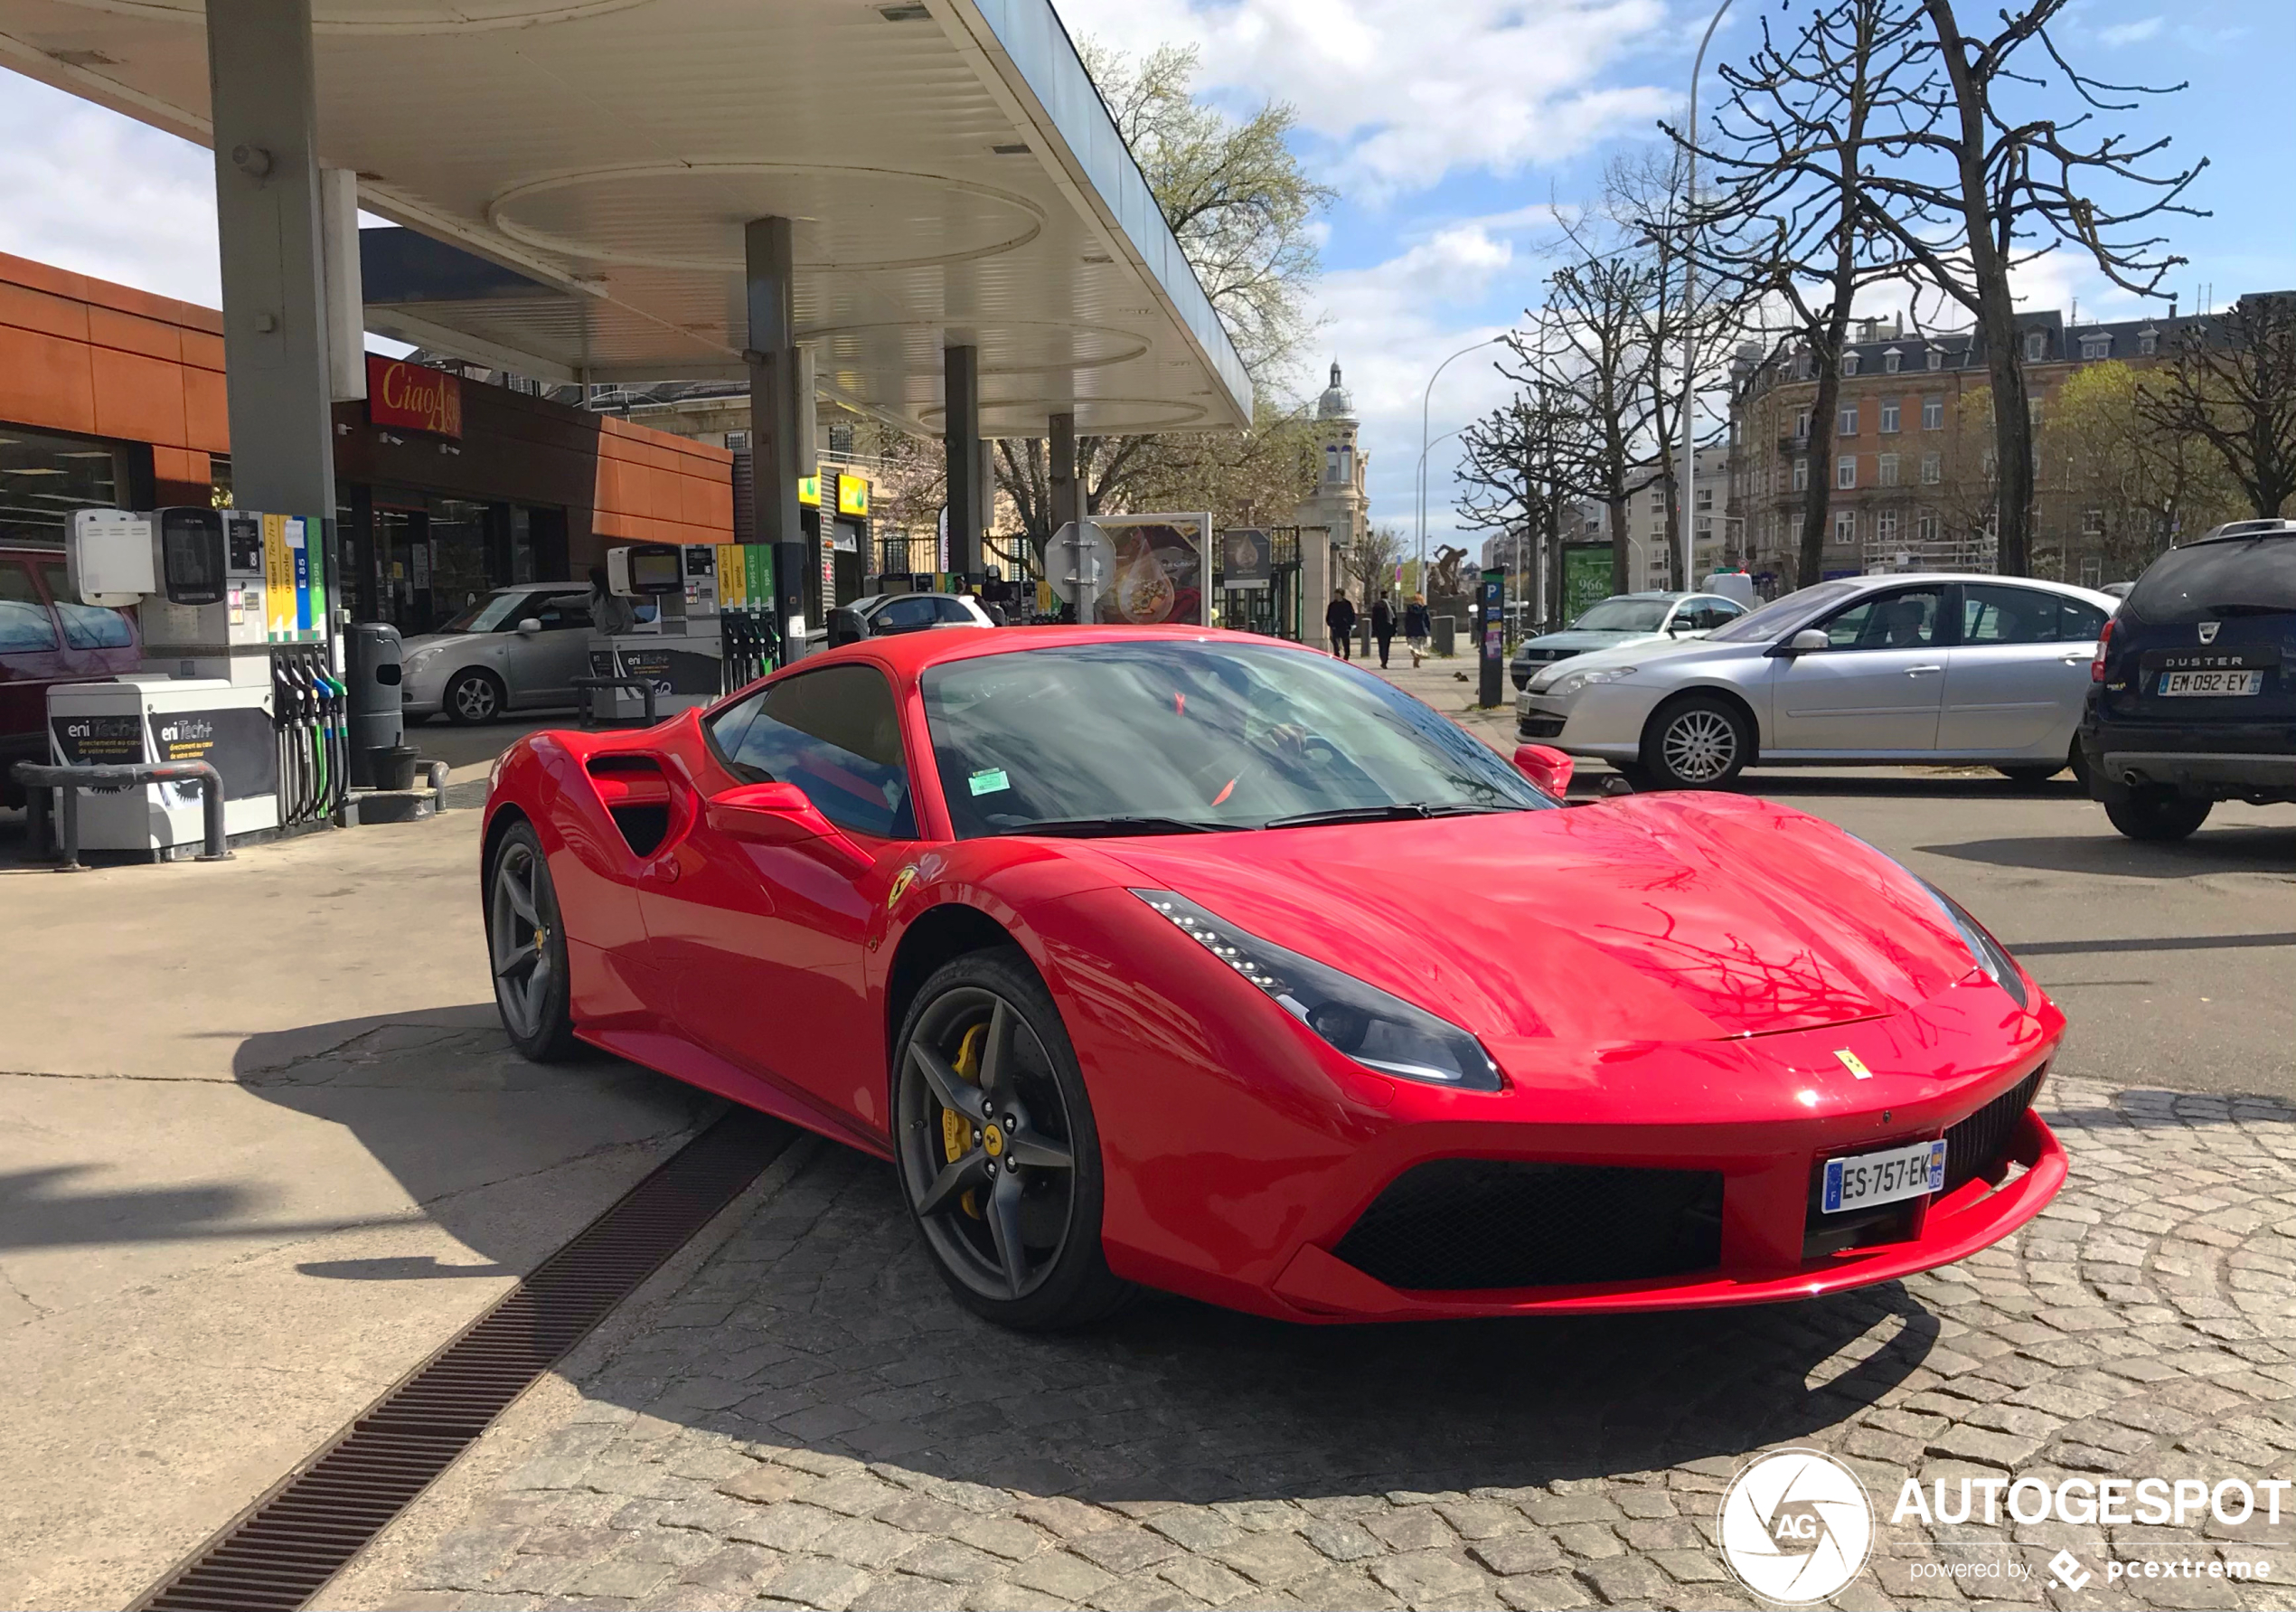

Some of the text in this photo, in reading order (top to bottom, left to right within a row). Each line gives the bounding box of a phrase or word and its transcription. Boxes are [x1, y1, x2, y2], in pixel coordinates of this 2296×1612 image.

[268, 521, 277, 557] Tech+
[249, 552, 258, 567] 8
[283, 553, 292, 594] gazole
[298, 558, 306, 589] E 85
[705, 565, 710, 574] 6
[735, 565, 743, 589] gazole
[748, 554, 757, 589] sp95-E10
[1487, 584, 1497, 599] P
[1578, 579, 1604, 590] 966
[627, 655, 641, 665] eni
[2165, 656, 2244, 667] DUSTER
[2171, 674, 2249, 692] EM-092-EY
[68, 720, 90, 737] eni
[161, 719, 213, 741] eni Tech+
[1830, 1154, 1943, 1202] F ES-757-EK 06
